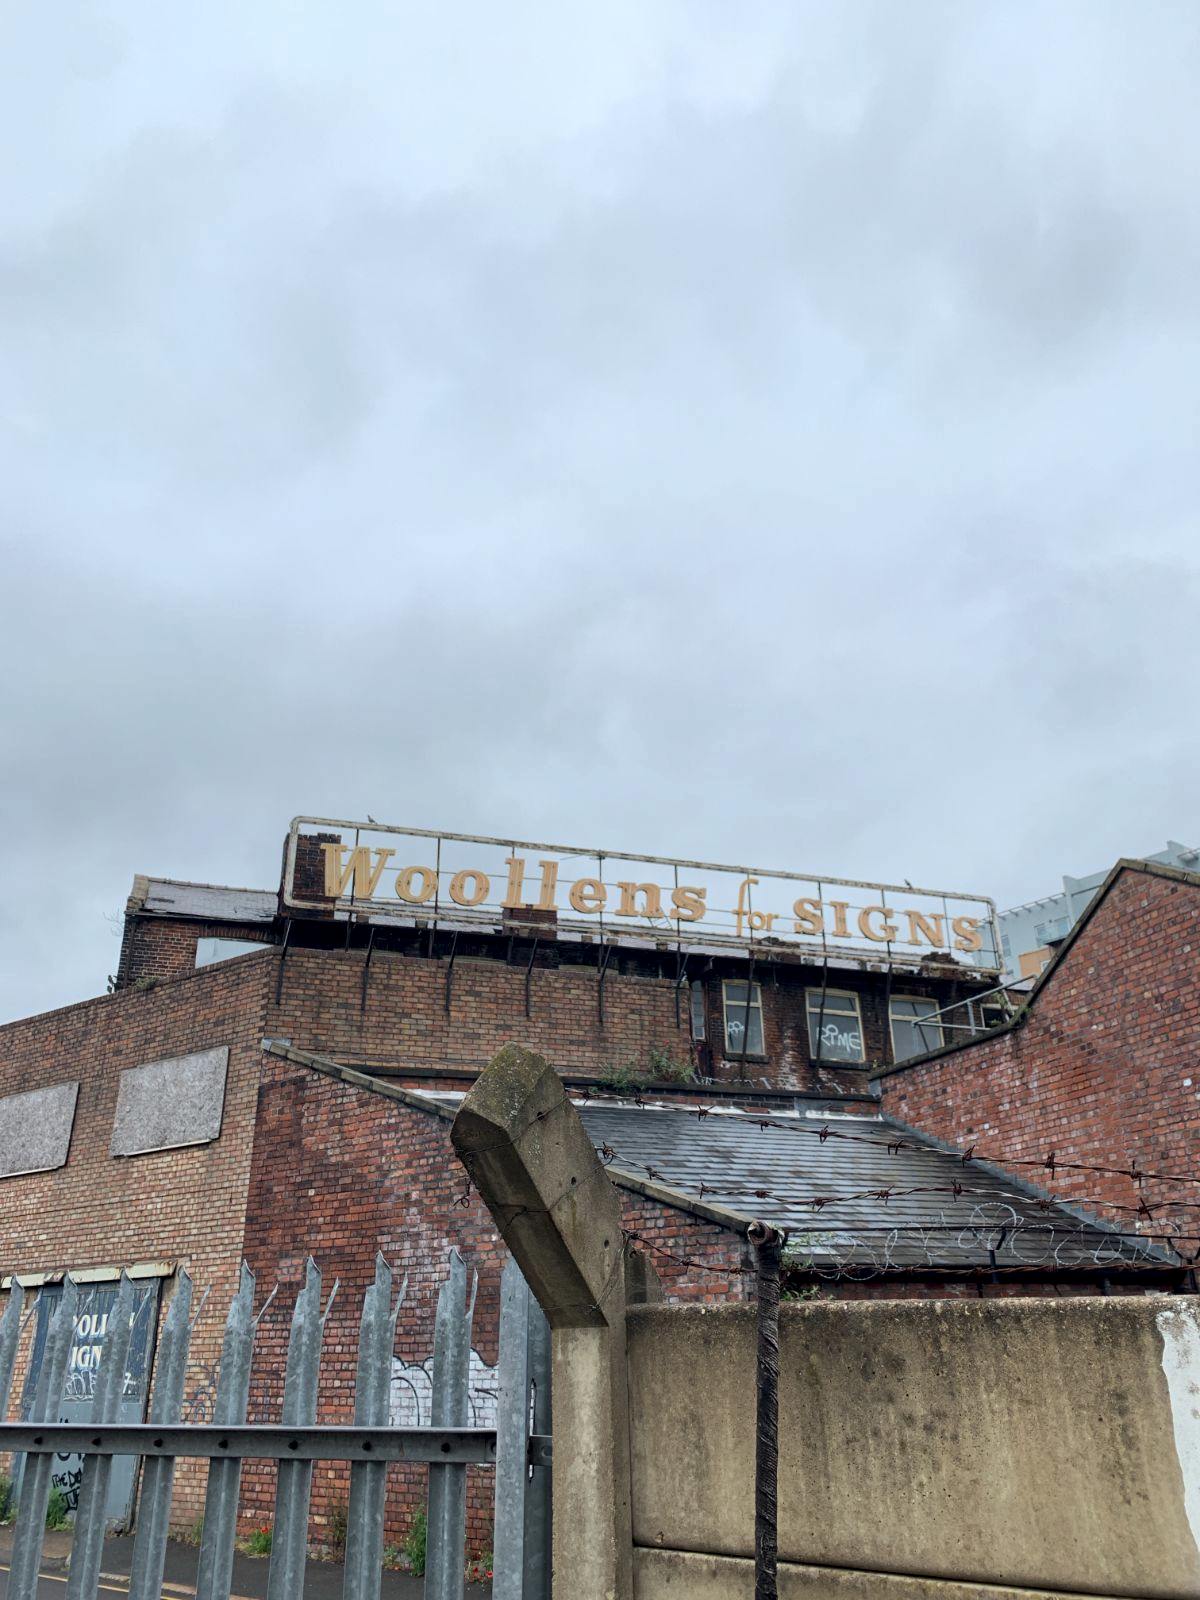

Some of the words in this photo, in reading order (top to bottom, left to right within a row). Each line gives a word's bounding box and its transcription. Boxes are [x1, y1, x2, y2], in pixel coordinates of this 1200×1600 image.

[320, 843, 707, 922] Woollens
[731, 878, 779, 937] for
[793, 898, 983, 953] SIGNS
